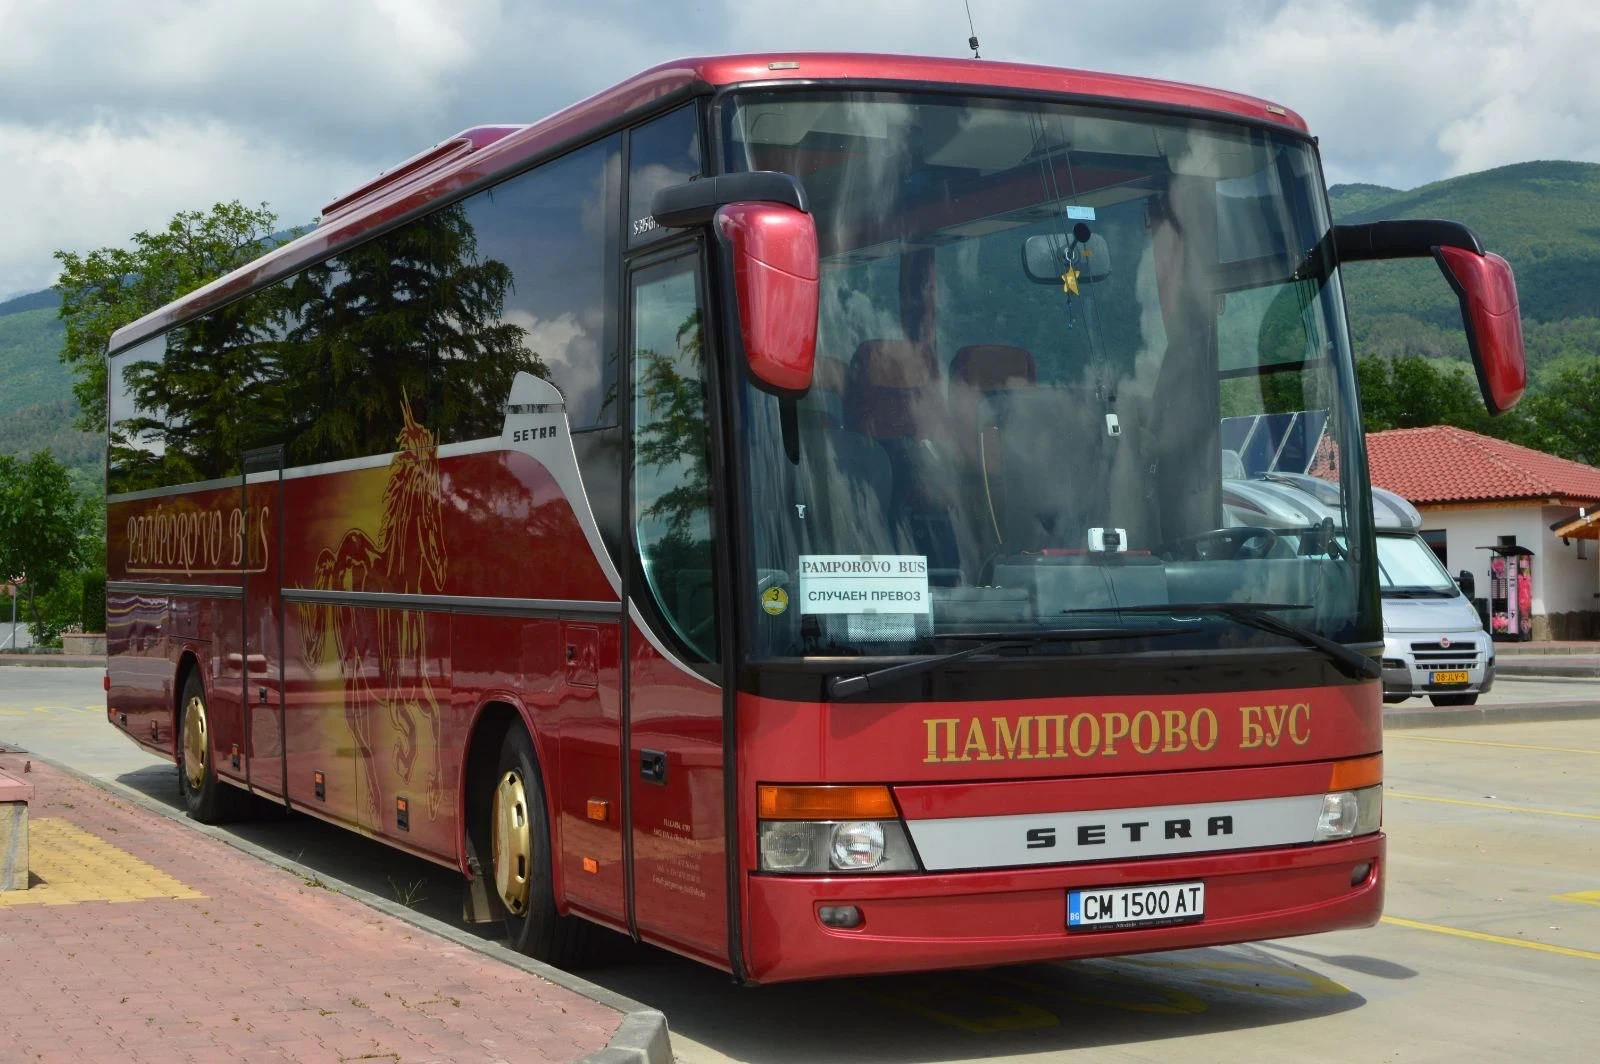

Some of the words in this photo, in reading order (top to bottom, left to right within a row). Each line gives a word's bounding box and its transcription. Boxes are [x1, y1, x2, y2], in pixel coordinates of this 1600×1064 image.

[513, 425, 557, 443] SETRA
[126, 503, 223, 577] PAMPOROVO
[801, 560, 891, 573] PAMPOROVO
[898, 560, 926, 573] BUS
[771, 589, 780, 601] 3
[808, 590, 868, 601] СЛУЧАЕН
[871, 590, 921, 601] ПРЕВОЗ
[923, 707, 1218, 763] ПАМПОРОВО
[1239, 703, 1311, 749] БУС
[1026, 815, 1233, 849] SETRA
[1084, 894, 1113, 920] CM
[1121, 890, 1170, 918] 1500
[1175, 887, 1201, 913] AT
[1069, 912, 1080, 921] BG
